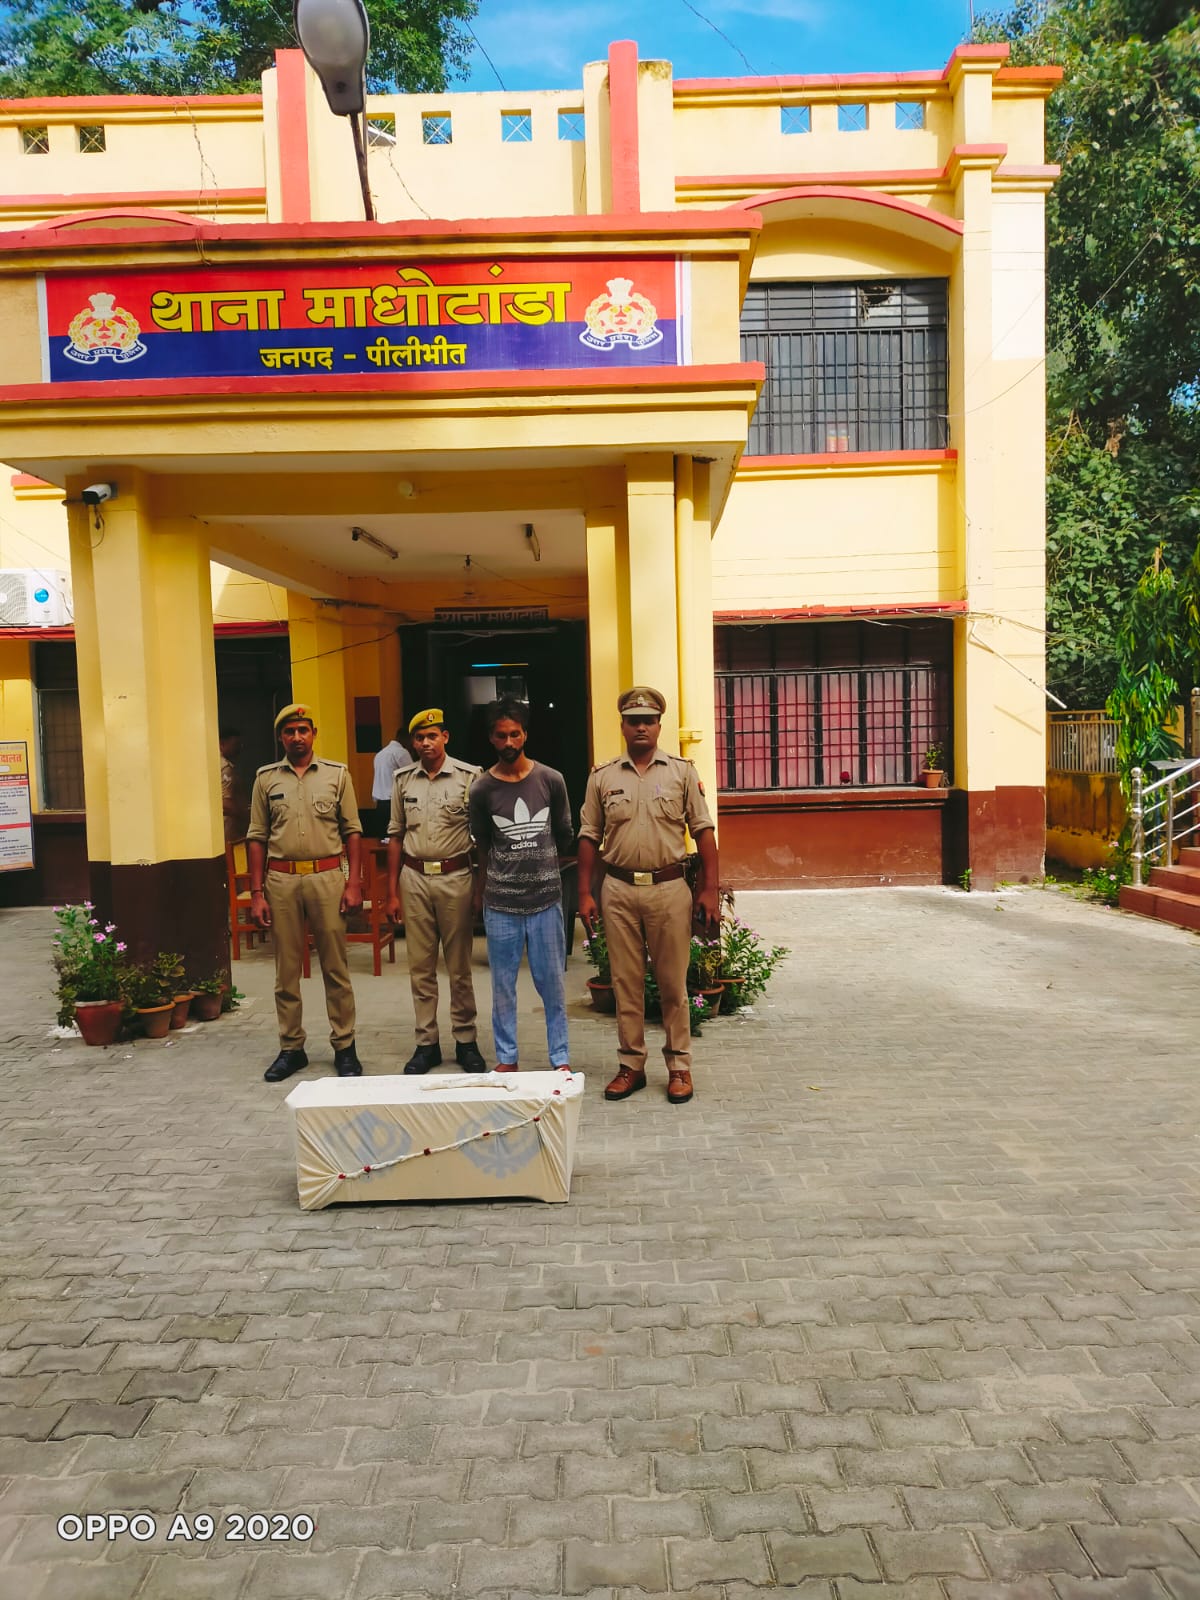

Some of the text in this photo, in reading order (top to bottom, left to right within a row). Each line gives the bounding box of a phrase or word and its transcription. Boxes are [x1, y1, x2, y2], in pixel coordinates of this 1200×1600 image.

[151, 263, 572, 333] थाना माधोटांडा
[259, 346, 334, 370] जनपद
[365, 334, 468, 368] पीलीभीत
